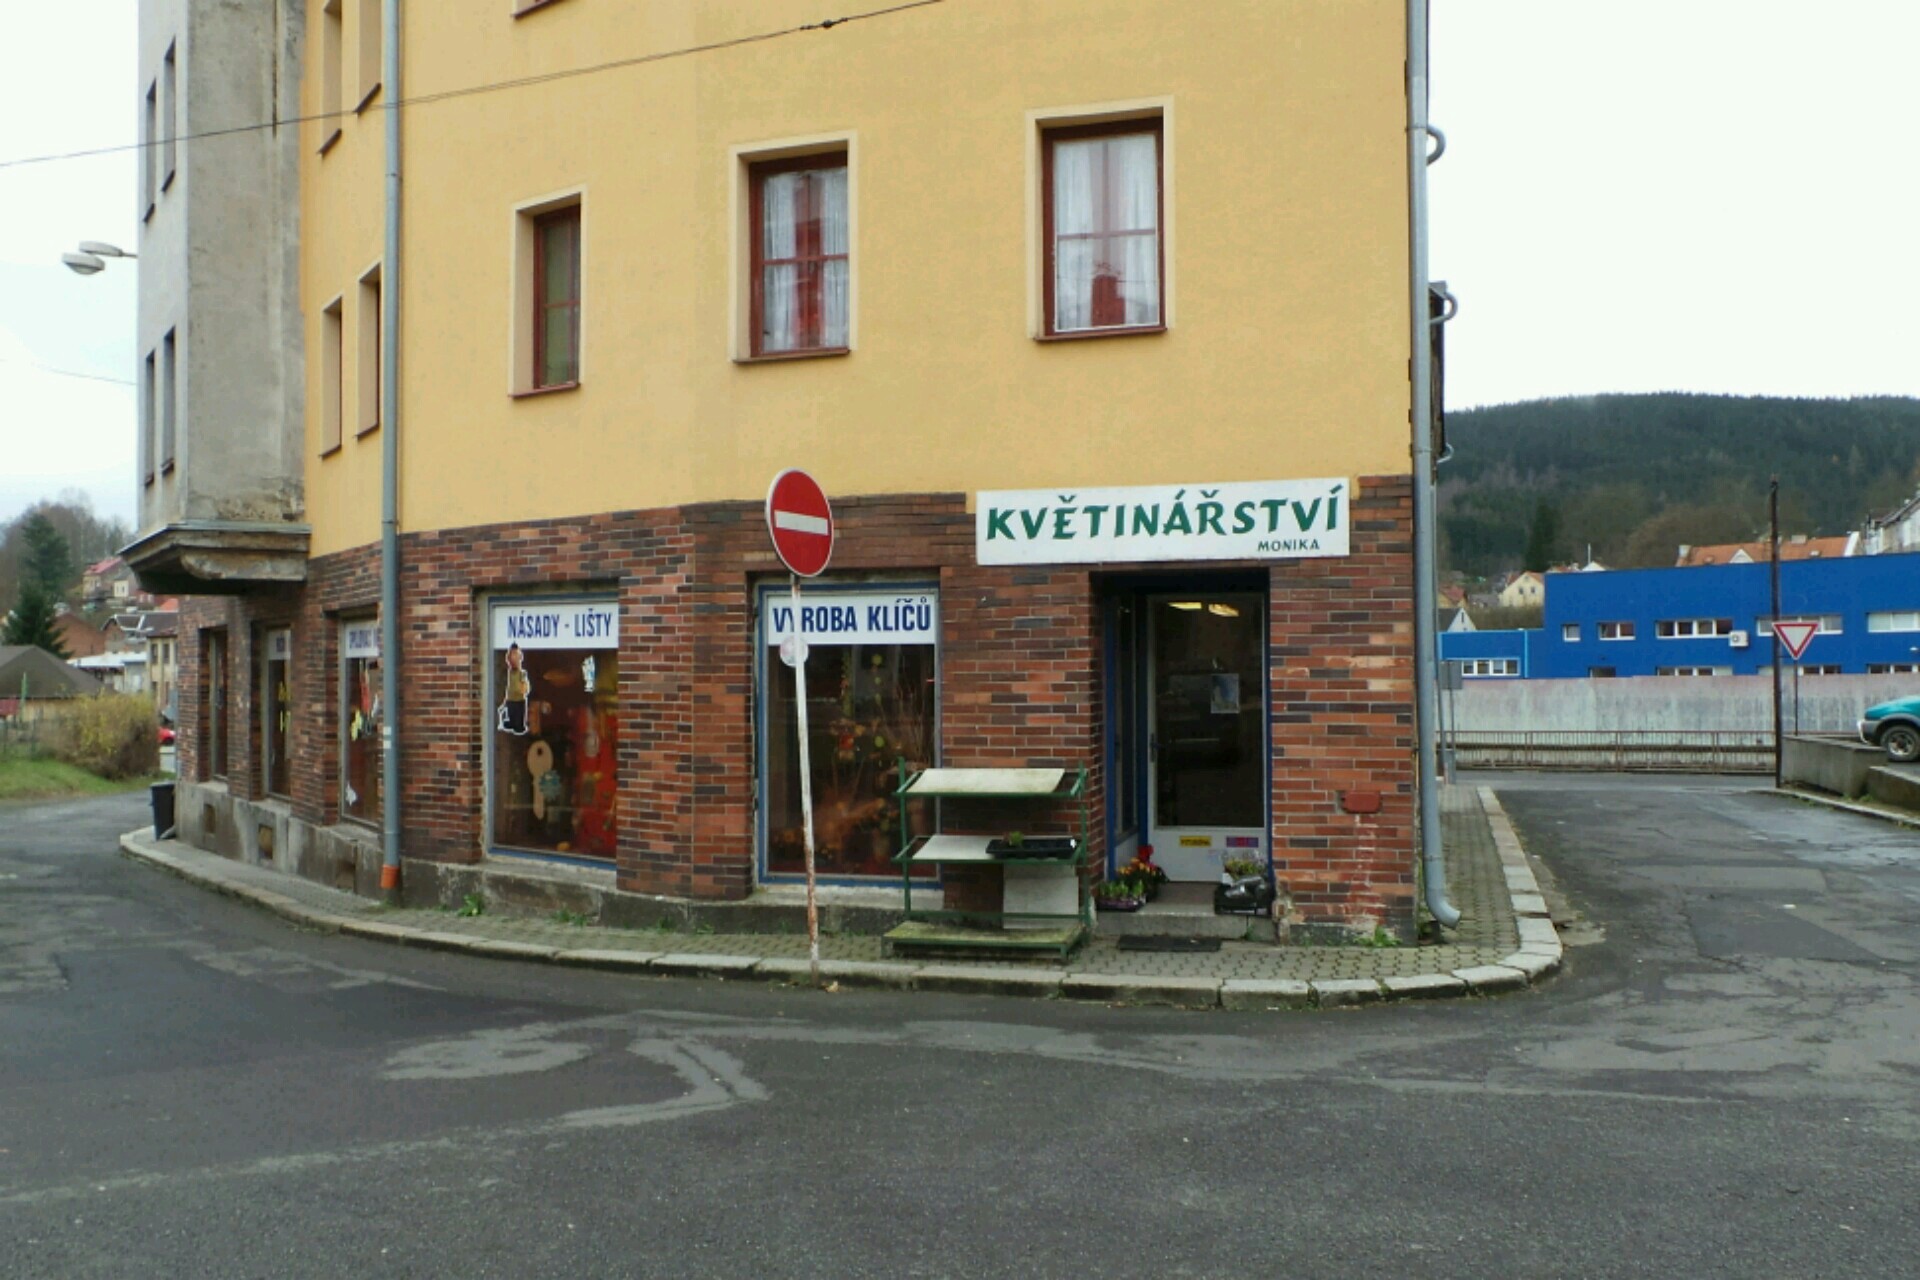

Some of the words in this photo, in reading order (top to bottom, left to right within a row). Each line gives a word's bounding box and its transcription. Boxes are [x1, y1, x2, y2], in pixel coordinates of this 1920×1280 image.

[986, 484, 1343, 540] KVĚTINÁŘSTVÍ
[1257, 538, 1320, 552] MONIKA
[507, 609, 560, 638] NÁSADY
[574, 607, 612, 637] LIŠTY
[867, 596, 931, 632] KLÍČŮ
